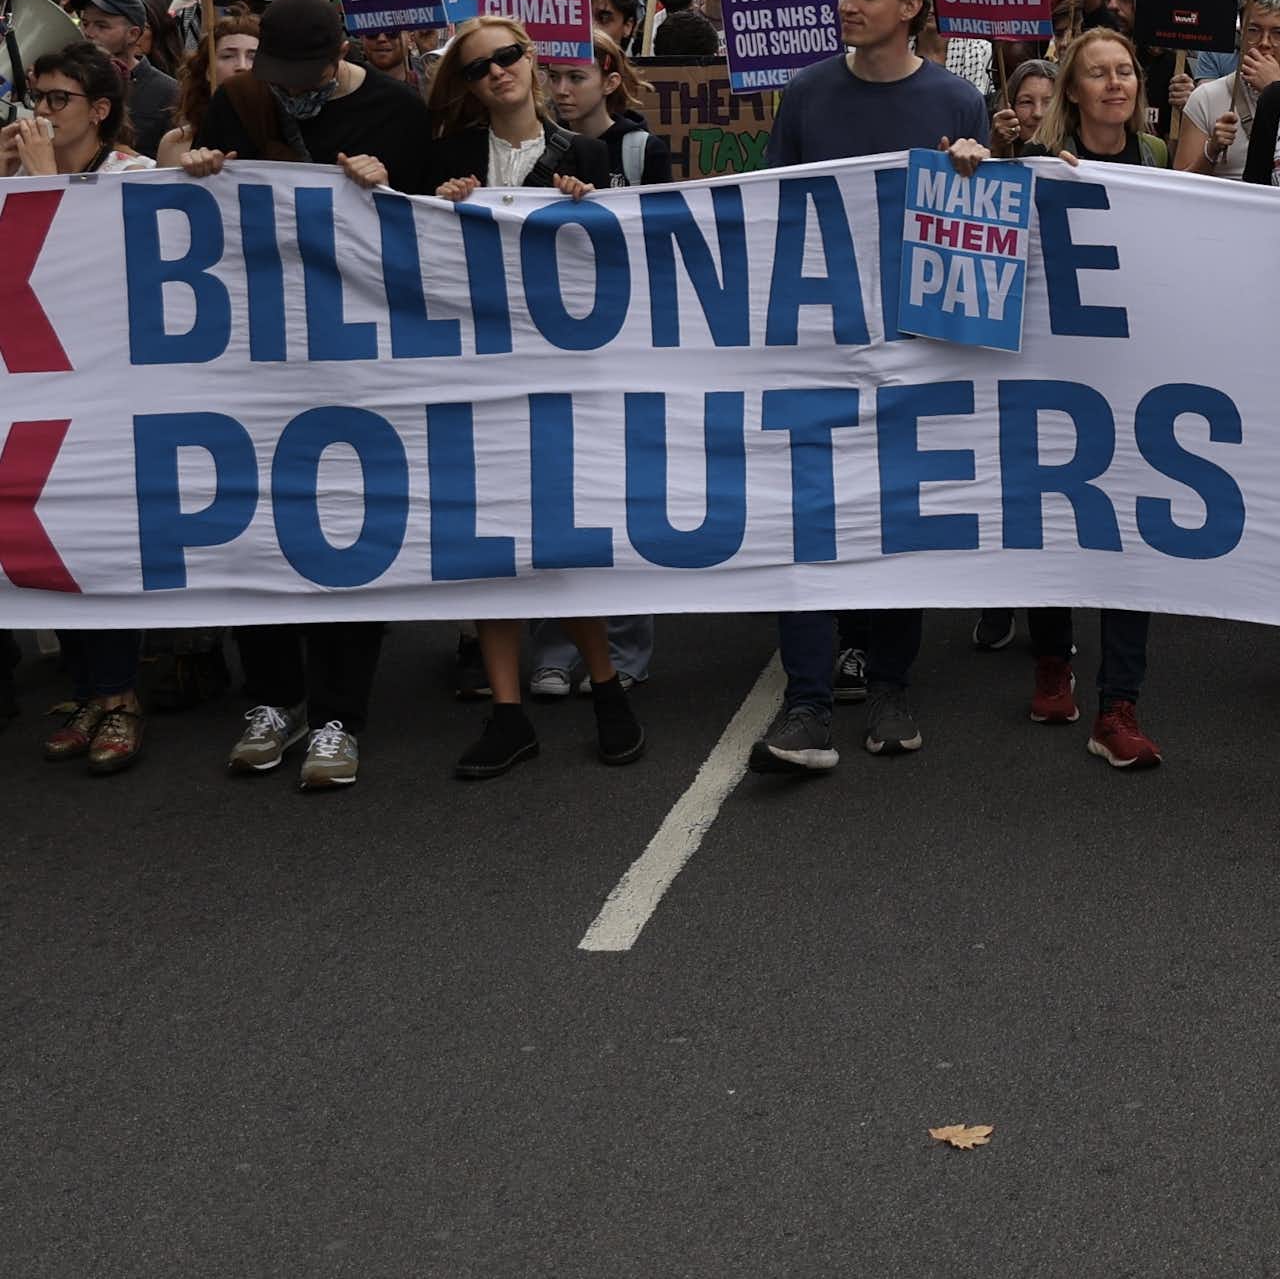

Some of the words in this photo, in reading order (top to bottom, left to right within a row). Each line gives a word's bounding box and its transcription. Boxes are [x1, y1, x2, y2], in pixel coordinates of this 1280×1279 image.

[732, 9, 775, 32] OUR
[777, 5, 818, 29] NHS
[820, 3, 836, 26] &
[735, 32, 769, 58] OUR
[770, 26, 838, 57] SCHOOLS
[689, 127, 772, 174] TAX
[916, 167, 1023, 223] MAKE
[914, 213, 1019, 257] THEM
[122, 166, 1130, 366] BILLIONAIE
[909, 246, 1018, 321] PAY
[133, 379, 1246, 590] POLLUTERS
